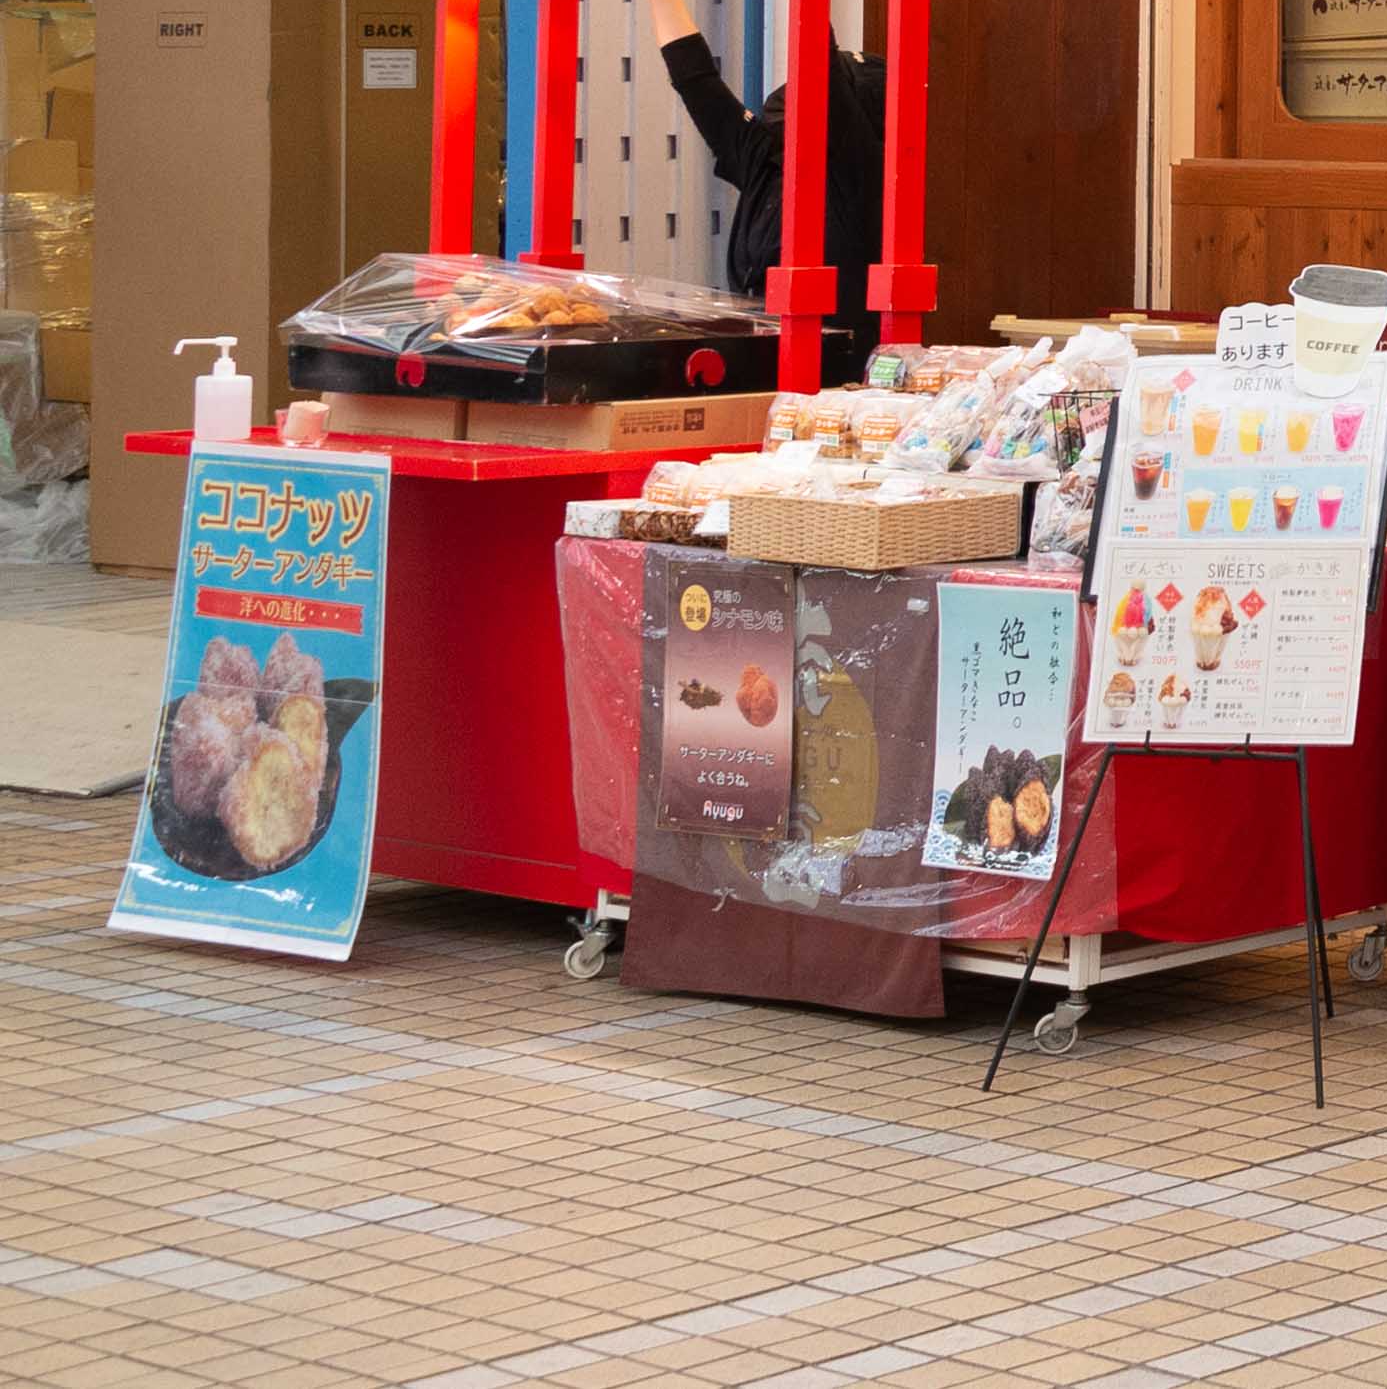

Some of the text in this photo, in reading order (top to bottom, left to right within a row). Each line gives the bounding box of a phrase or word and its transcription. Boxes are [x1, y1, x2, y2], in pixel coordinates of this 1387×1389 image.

[160, 23, 205, 37] RIGHT
[364, 24, 414, 37] BACK
[1229, 313, 1295, 331] コーヒー
[1222, 342, 1289, 362] あります
[1306, 339, 1361, 355] COFFEE
[1233, 377, 1282, 392] DRINK
[200, 480, 373, 547] ココナッツ
[192, 543, 374, 591] サーターアンダギー
[1208, 563, 1265, 579] SWEETS
[711, 609, 784, 633] シナモン味
[998, 617, 1030, 729] 絶品。
[679, 746, 775, 765] サーターアンダギーに
[697, 769, 750, 788] よく合うね。
[703, 799, 744, 822] Ryugu
